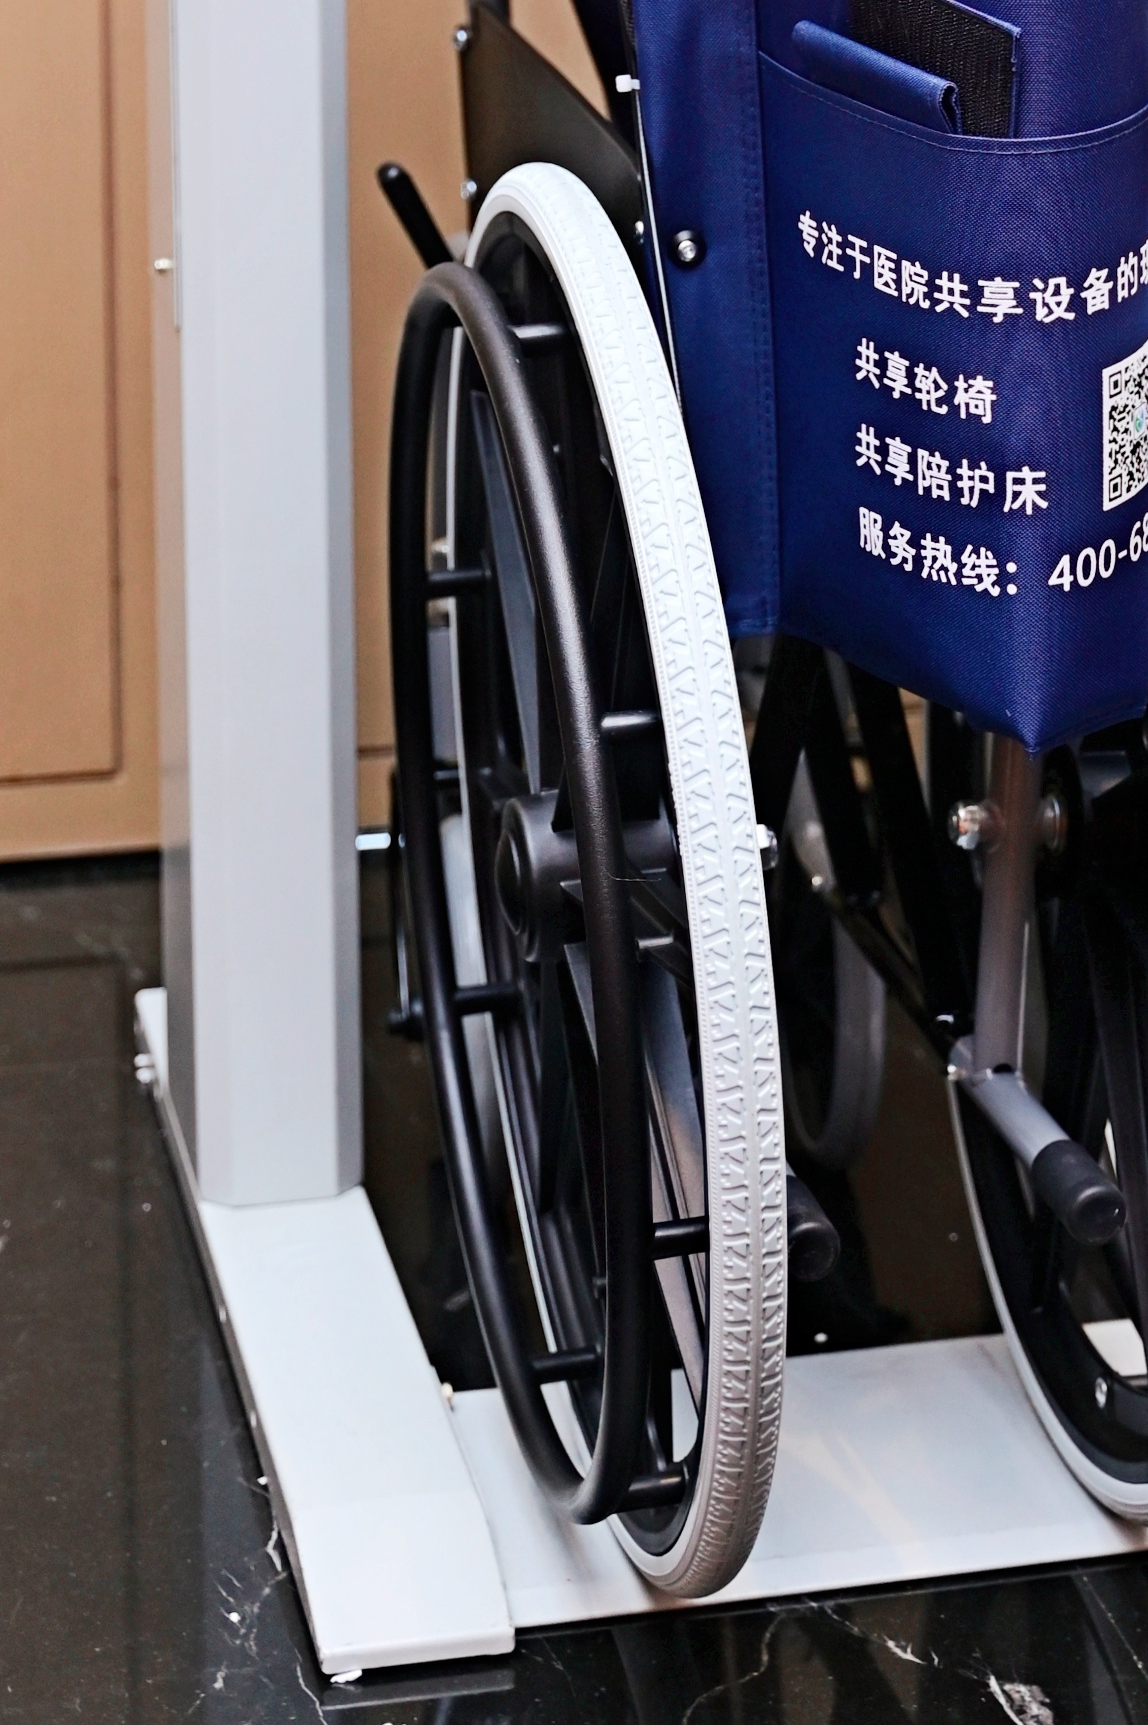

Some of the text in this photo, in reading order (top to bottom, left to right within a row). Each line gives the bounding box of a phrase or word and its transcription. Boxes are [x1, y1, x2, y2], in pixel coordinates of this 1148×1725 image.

[855, 338, 997, 424] 共享轮椅
[855, 423, 1049, 515] 共享陪护床
[859, 507, 1018, 597] 服务热线：
